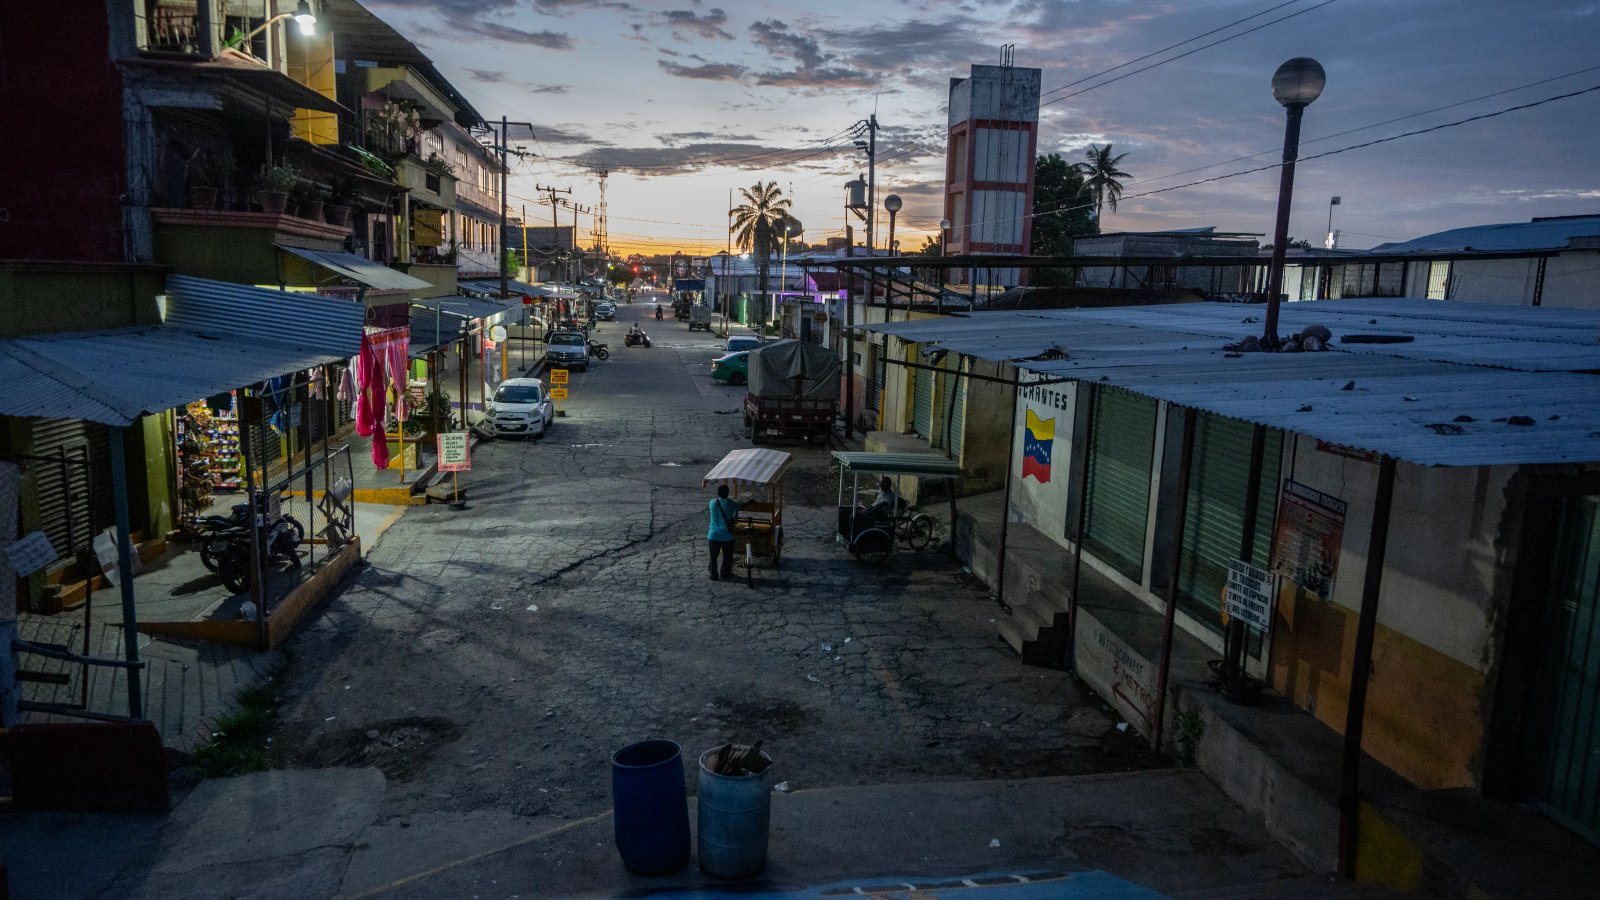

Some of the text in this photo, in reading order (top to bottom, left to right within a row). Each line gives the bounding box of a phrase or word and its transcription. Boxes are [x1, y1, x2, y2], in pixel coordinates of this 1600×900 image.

[1019, 385, 1068, 410] IGRANTES
[1229, 559, 1245, 574] SUBIDA
[1232, 571, 1238, 582] DE
[1249, 600, 1265, 615] FRENTE
[1114, 660, 1119, 674] 2
